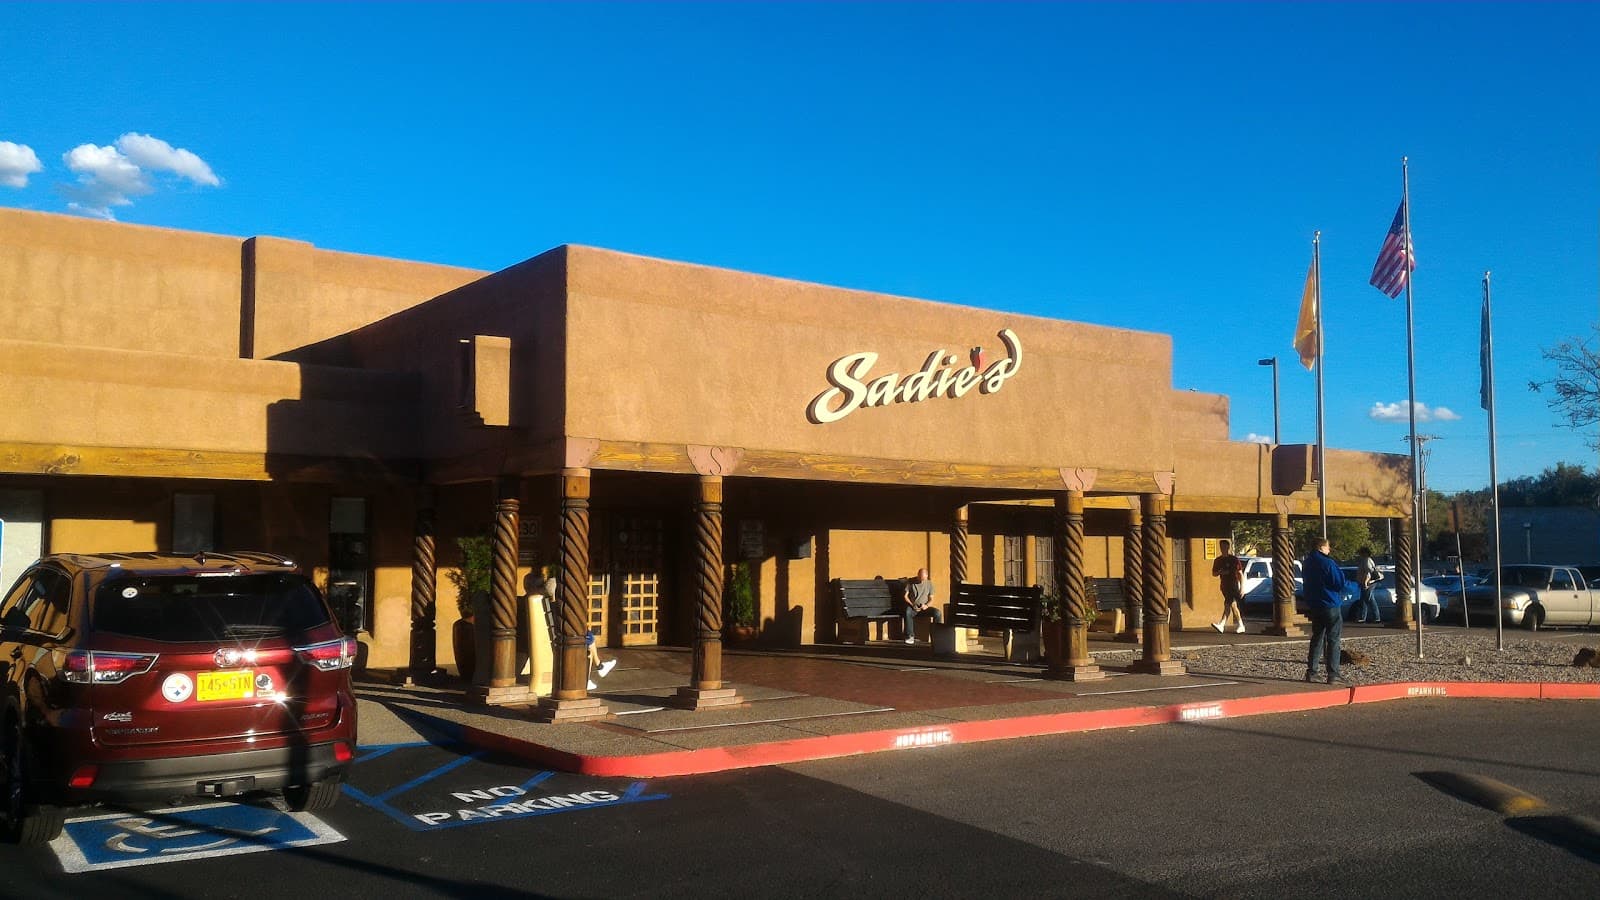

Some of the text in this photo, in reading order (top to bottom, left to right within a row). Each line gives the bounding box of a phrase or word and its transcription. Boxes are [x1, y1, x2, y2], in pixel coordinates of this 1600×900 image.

[807, 328, 1023, 424] Sadie's
[414, 790, 620, 826] PARKING
[451, 785, 527, 803] NO
